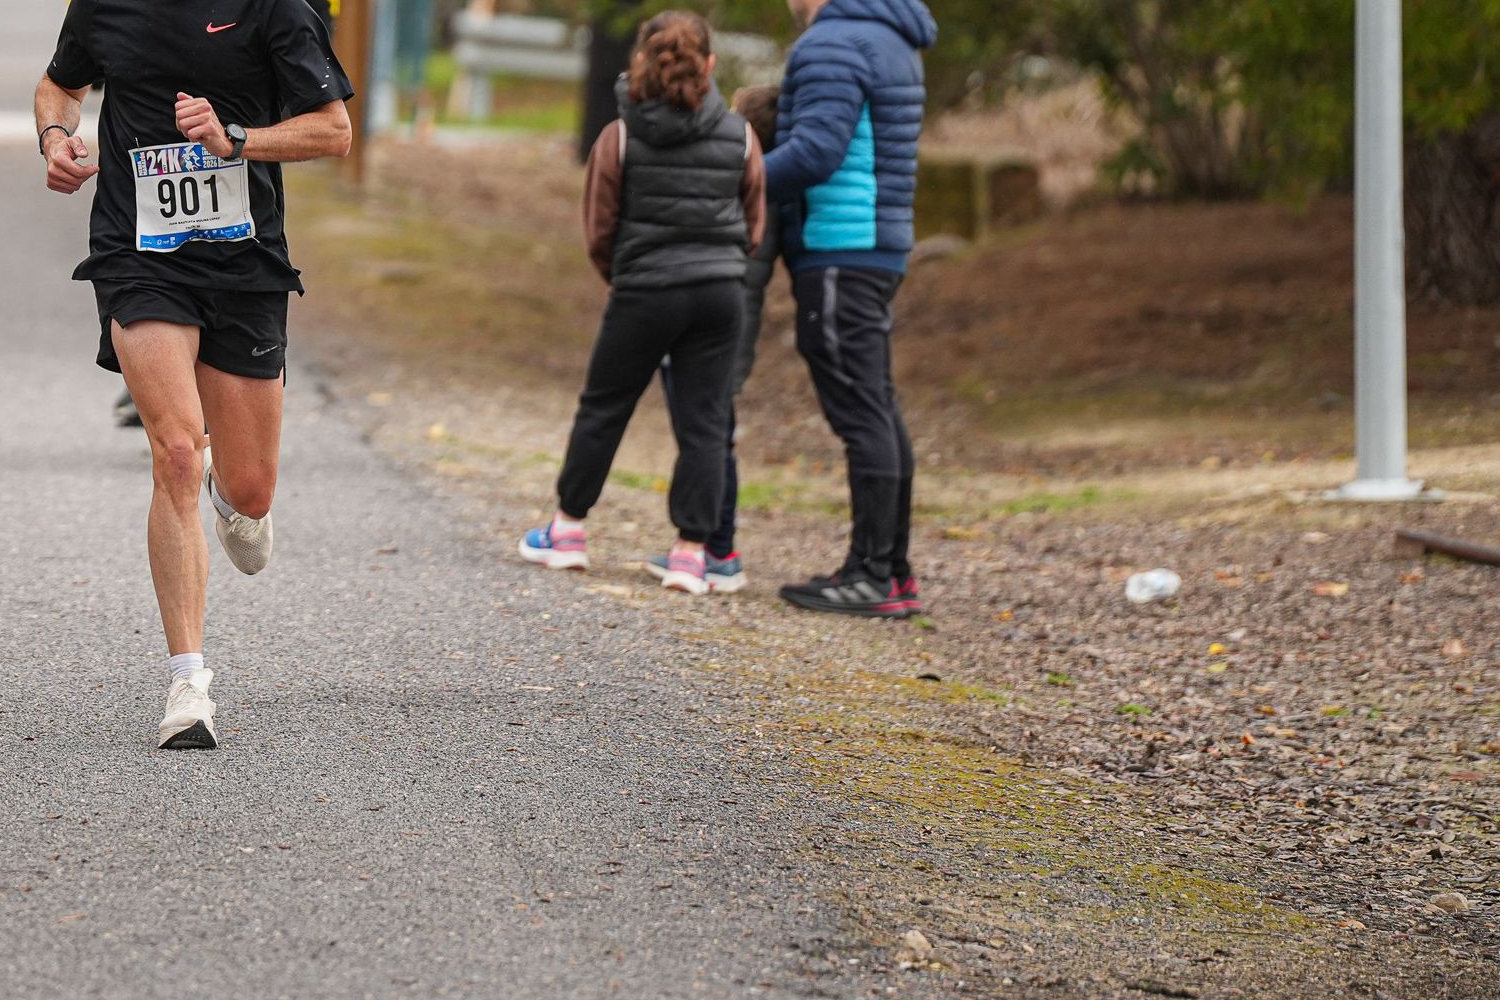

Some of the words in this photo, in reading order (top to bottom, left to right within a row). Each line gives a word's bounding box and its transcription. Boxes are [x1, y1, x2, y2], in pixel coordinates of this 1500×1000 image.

[146, 148, 182, 175] 21K
[203, 160, 218, 169] 2026
[157, 174, 219, 218] 901
